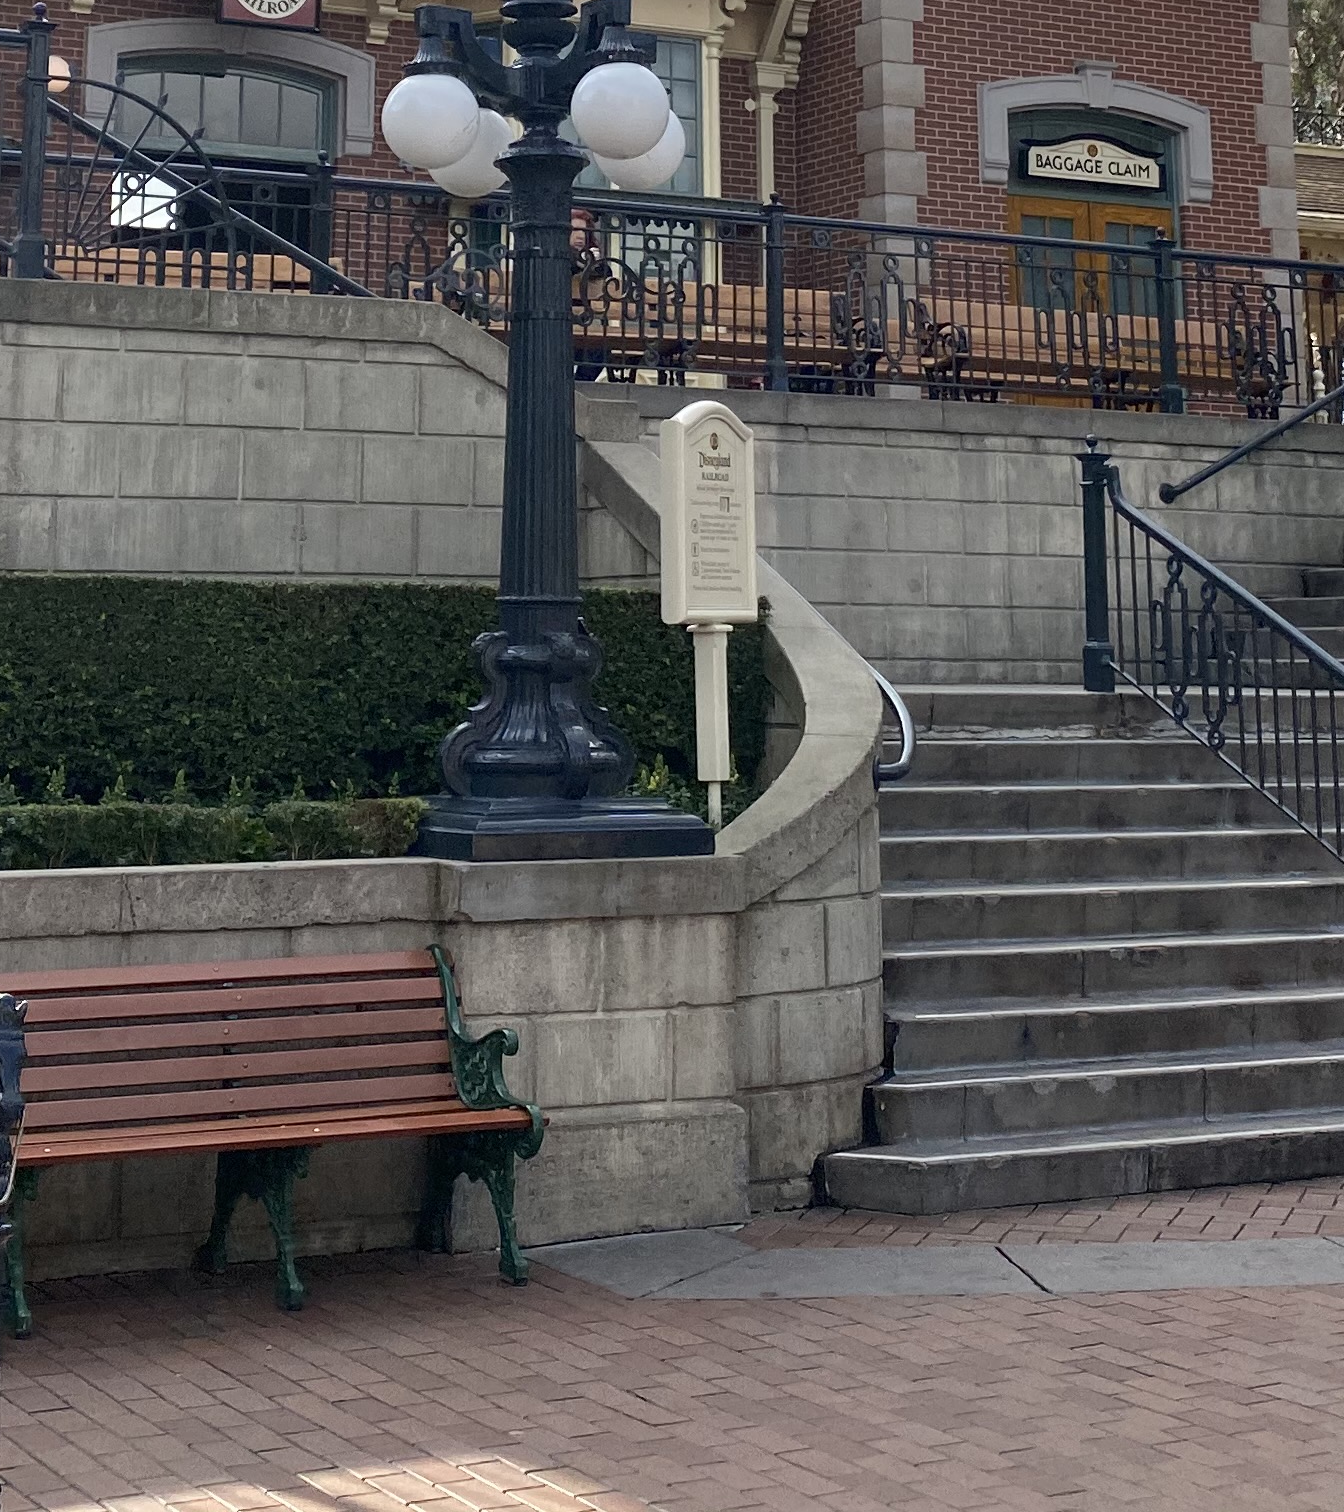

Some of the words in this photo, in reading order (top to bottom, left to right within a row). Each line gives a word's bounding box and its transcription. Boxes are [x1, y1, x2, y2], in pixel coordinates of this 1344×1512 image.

[1036, 154, 1103, 174] BAGGAGE
[1108, 162, 1150, 178] CLAIM
[698, 451, 731, 470] Disneyland
